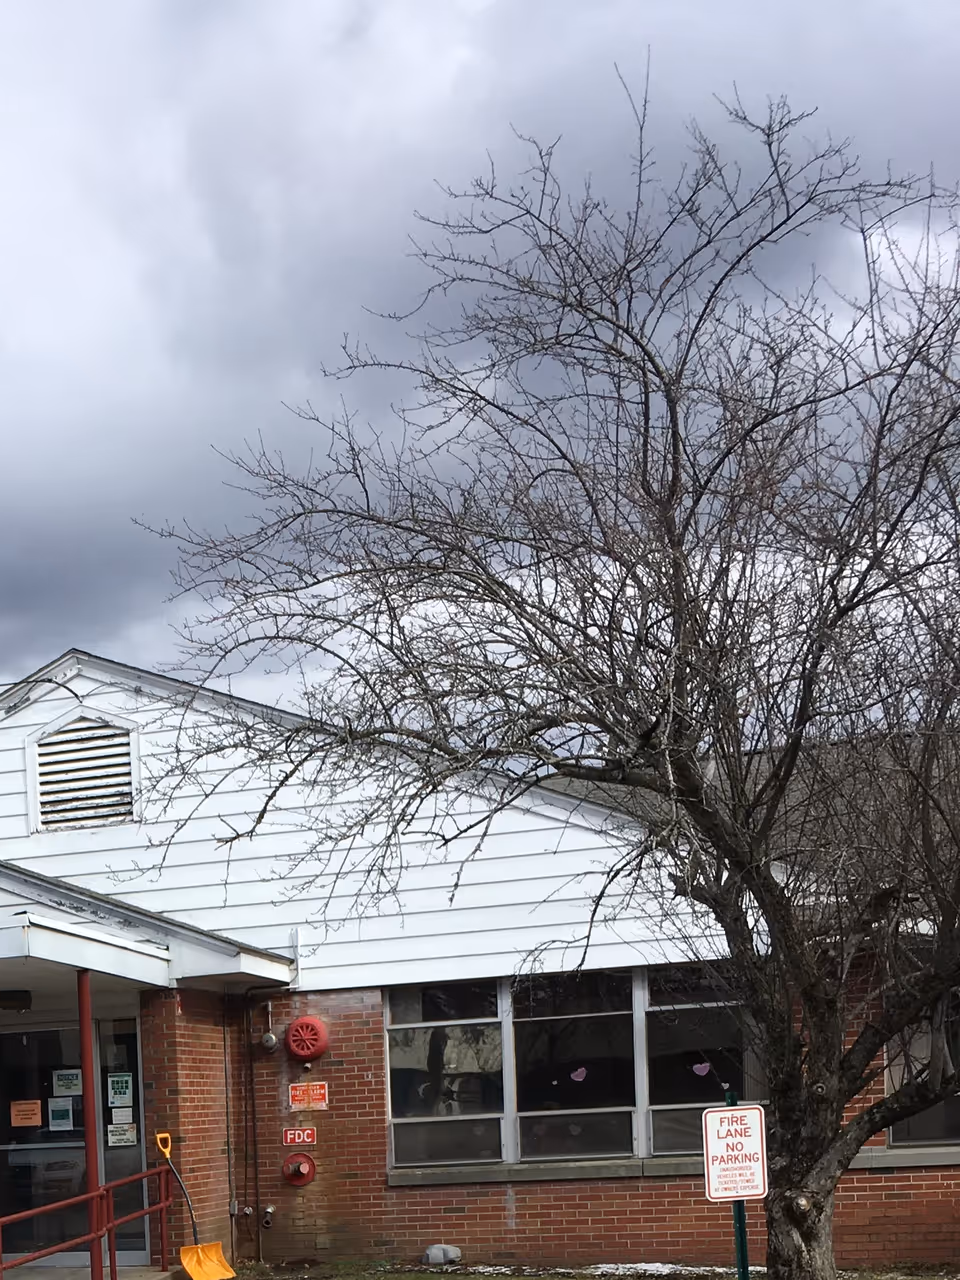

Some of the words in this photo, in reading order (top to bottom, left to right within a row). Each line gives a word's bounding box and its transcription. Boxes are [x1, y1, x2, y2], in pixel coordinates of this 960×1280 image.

[720, 1115, 748, 1127] FIRE
[287, 1130, 312, 1143] FDC
[717, 1127, 751, 1139] LANE
[726, 1141, 744, 1152] NO
[712, 1152, 759, 1165] PARKING
